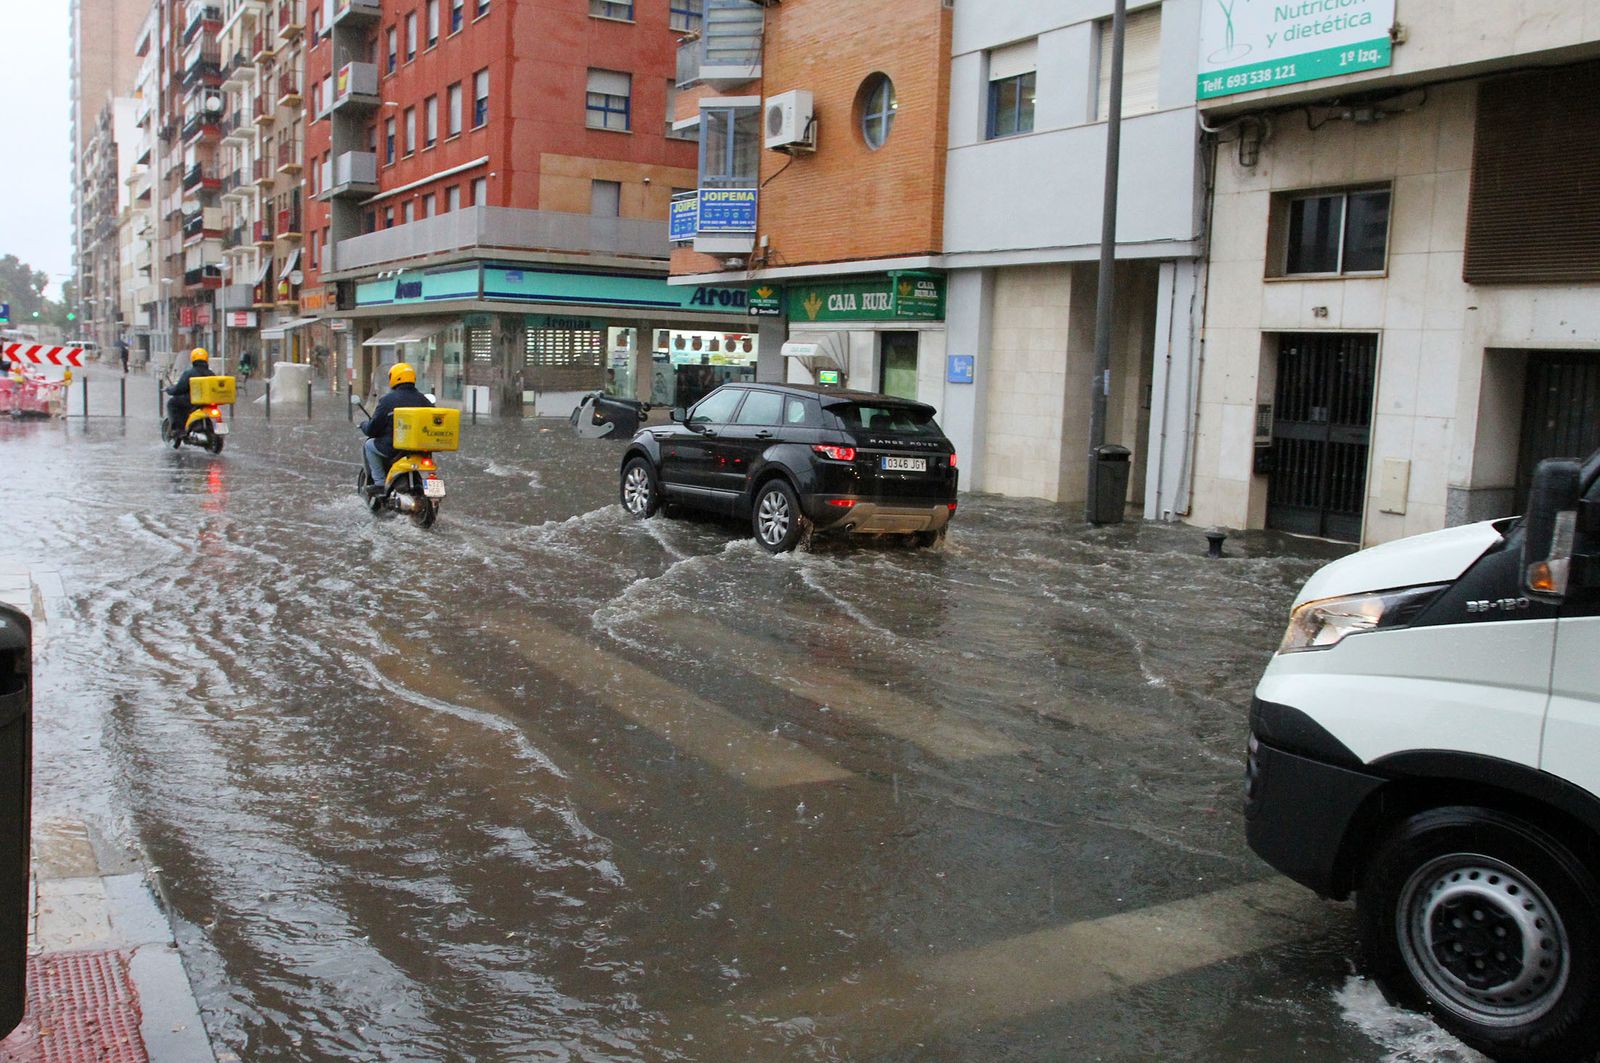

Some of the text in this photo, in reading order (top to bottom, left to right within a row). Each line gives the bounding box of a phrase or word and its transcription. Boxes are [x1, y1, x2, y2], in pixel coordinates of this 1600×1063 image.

[1266, 11, 1372, 48] y dietética
[1203, 49, 1382, 92] Telf. 693 538 121 1º Izq.
[701, 191, 754, 201] JOIPEMA
[673, 201, 697, 212] JOIPE
[828, 292, 893, 311] CAJA RURA
[887, 458, 925, 470] 0346 JGY
